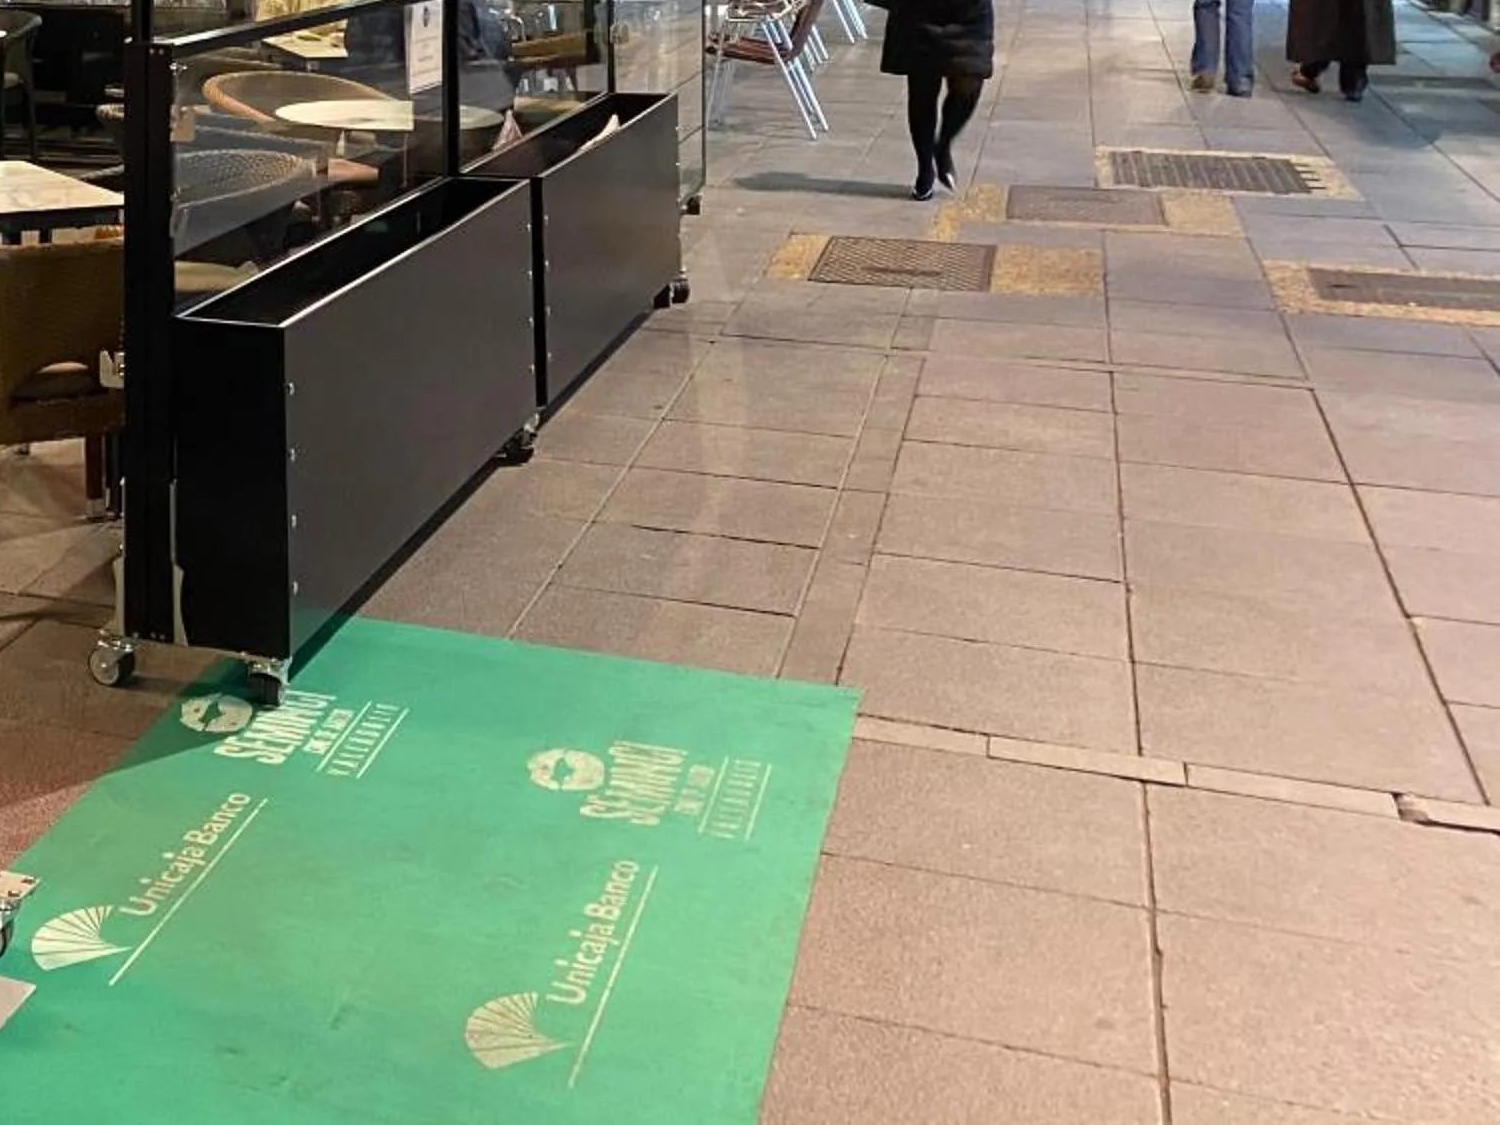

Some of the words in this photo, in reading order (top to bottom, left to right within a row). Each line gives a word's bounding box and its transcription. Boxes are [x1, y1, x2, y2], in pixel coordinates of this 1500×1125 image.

[119, 845, 207, 916] Unicaja
[183, 793, 251, 846] Banco
[546, 922, 620, 1004] Unicaja
[583, 859, 639, 921] Banco
